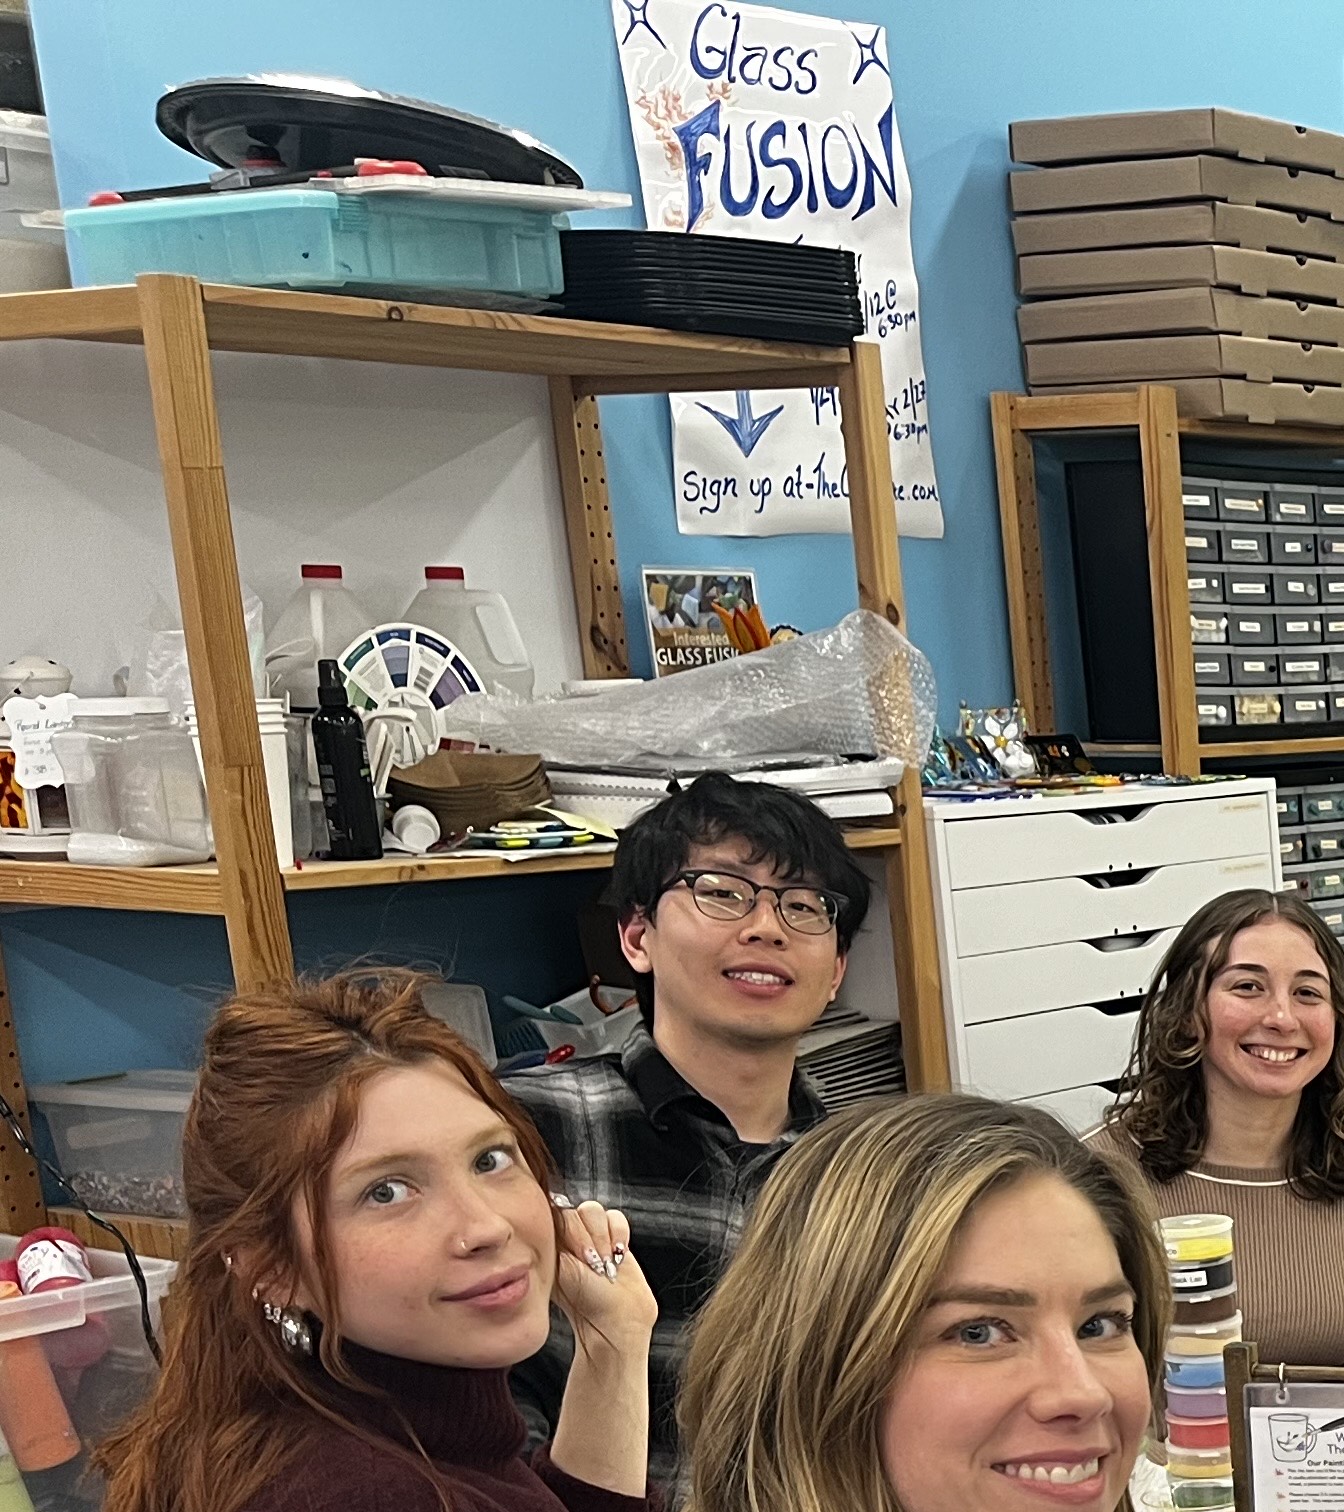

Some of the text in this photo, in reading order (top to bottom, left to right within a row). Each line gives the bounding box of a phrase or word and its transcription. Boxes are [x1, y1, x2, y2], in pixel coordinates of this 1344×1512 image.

[690, 3, 818, 95] Glass
[672, 101, 899, 232] FUSION
[683, 470, 738, 515] Sign
[750, 476, 772, 514] up
[656, 647, 702, 666] GLASS
[1306, 1459, 1322, 1467] Our
